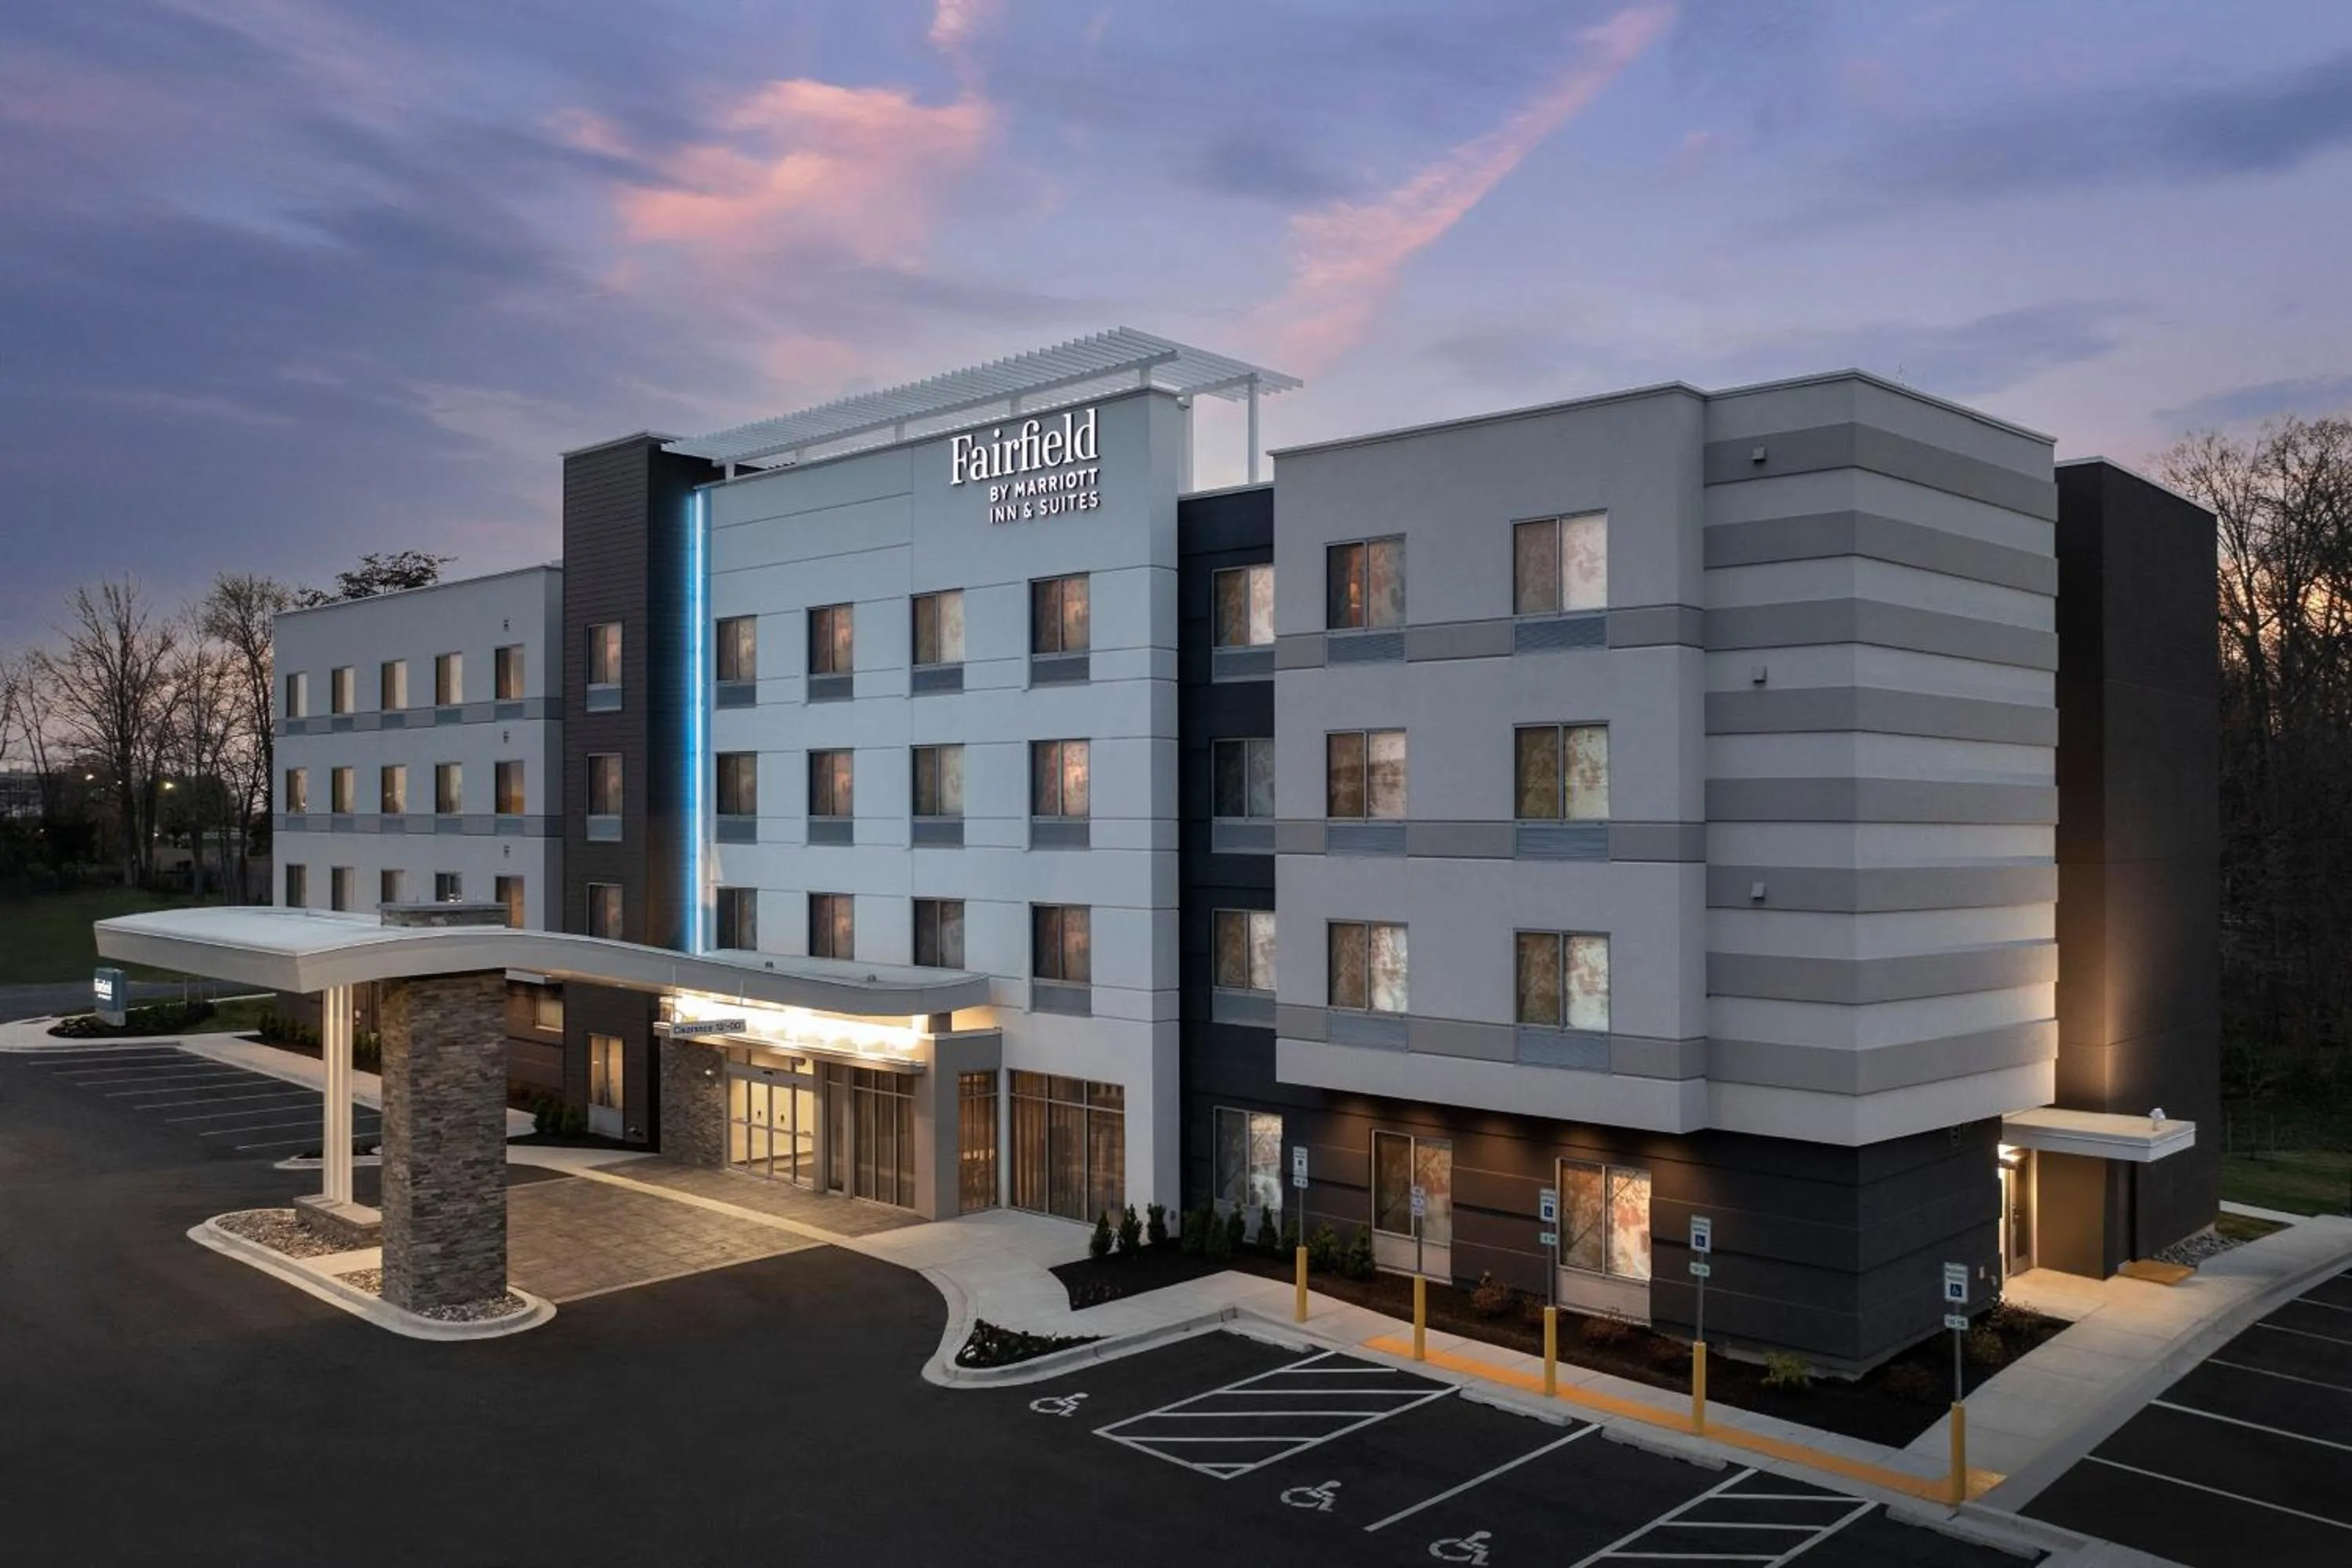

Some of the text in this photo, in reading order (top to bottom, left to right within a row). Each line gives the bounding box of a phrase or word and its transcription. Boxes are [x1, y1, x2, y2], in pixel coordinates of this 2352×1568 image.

[950, 408, 1098, 485] Fairfield
[990, 469, 1098, 502] BY MARRIOTT
[990, 491, 1098, 523] INN & SUITES
